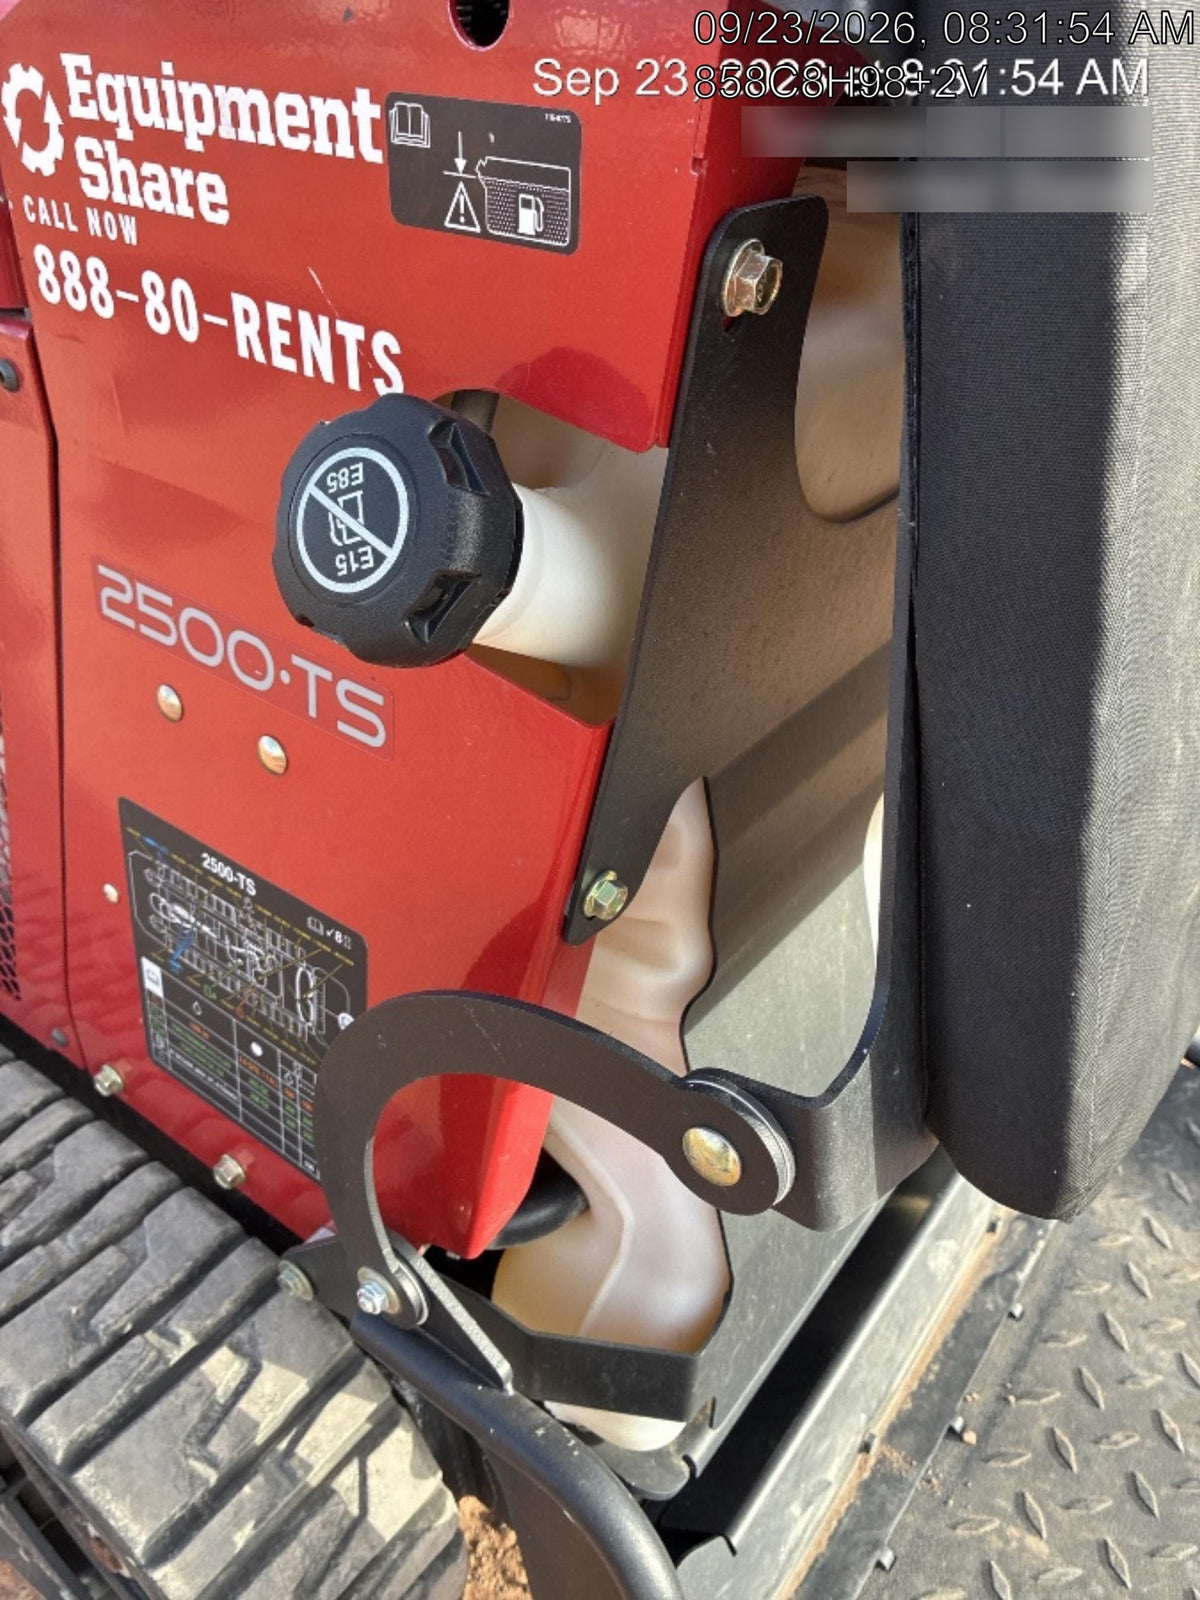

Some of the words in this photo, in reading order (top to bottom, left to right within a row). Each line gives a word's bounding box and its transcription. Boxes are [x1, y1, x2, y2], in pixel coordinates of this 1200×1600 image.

[60, 53, 384, 164] Equipment
[74, 135, 230, 226] Share
[23, 194, 79, 233] CALL
[86, 206, 138, 246] NOW
[33, 243, 404, 398] 888-80-RENTS
[326, 461, 364, 494] E85
[334, 545, 375, 577] E15
[202, 852, 257, 896] 2500-TS
